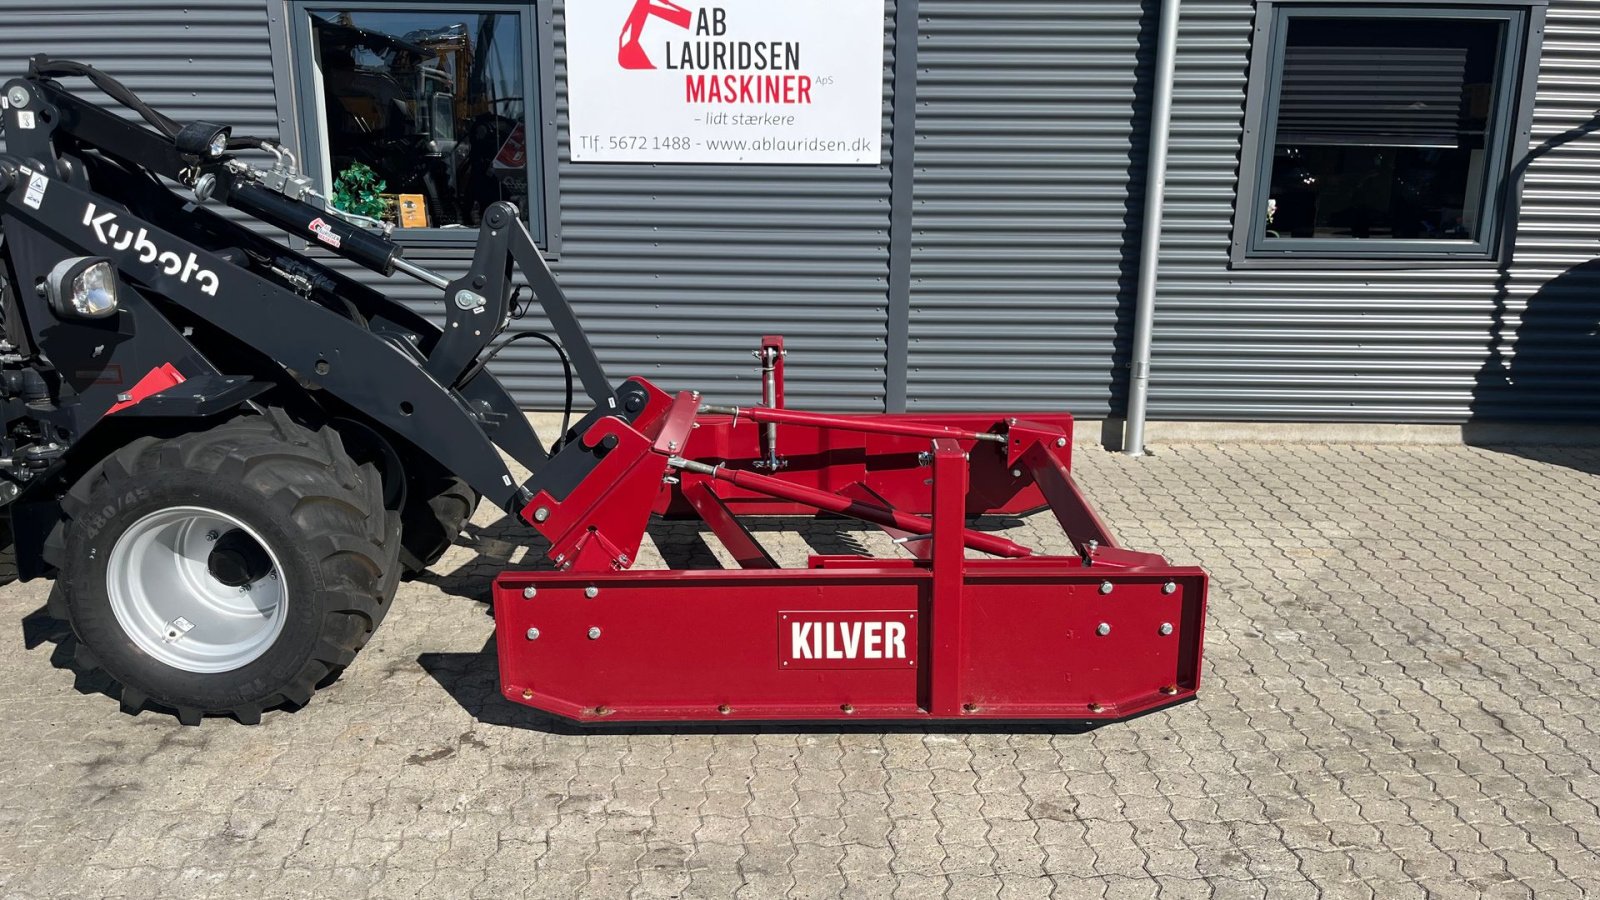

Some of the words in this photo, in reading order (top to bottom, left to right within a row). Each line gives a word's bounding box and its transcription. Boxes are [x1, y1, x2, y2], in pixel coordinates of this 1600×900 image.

[695, 7, 727, 36] AB
[666, 40, 801, 71] LAURIDSEN
[685, 74, 812, 105] MASKINER
[815, 75, 834, 86] ApS
[705, 111, 728, 126] lidt
[731, 112, 795, 127] stærkere
[579, 135, 603, 153] Tlf.
[608, 136, 647, 151] 5672
[652, 136, 691, 151] 1488
[706, 136, 872, 153] www.ablauridsen.dk
[82, 202, 220, 297] Kubota
[791, 621, 907, 660] KILVER
